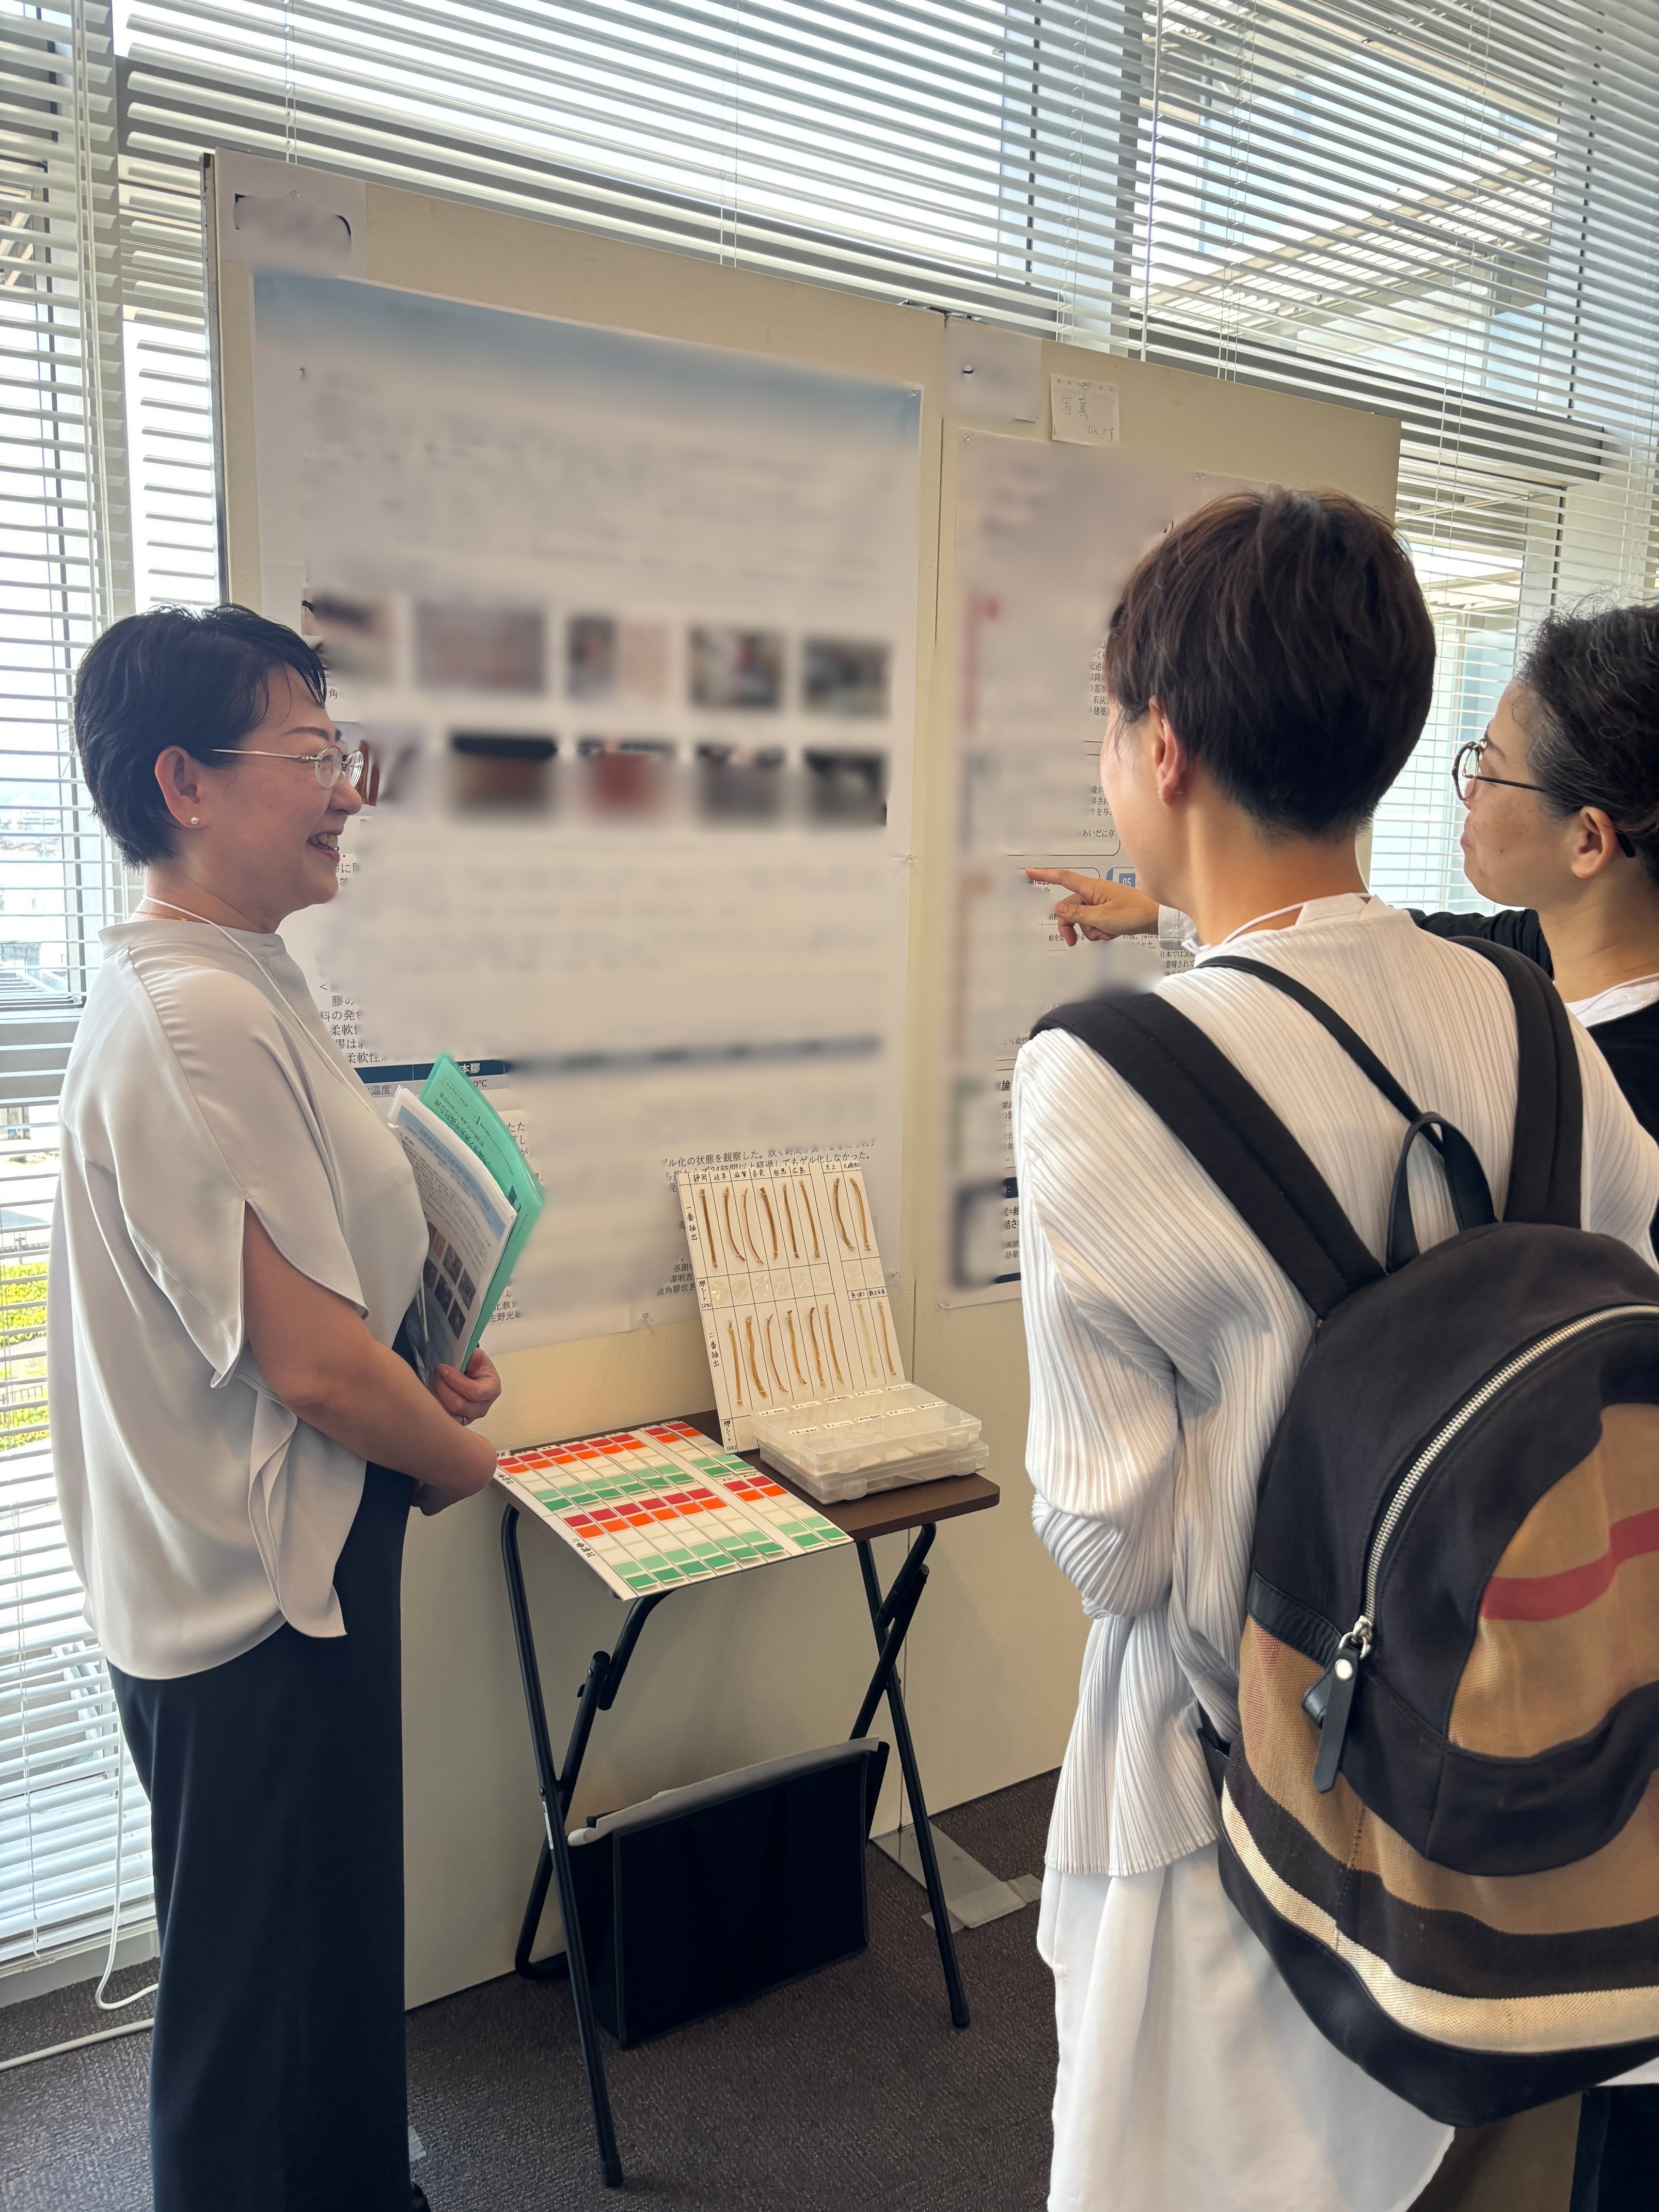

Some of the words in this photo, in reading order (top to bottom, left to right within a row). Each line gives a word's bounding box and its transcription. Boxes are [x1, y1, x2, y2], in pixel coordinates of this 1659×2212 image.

[1062, 397, 1088, 417] 写真
[345, 1052, 387, 1064] 柔軟性
[368, 1085, 391, 1096] 温度
[686, 1206, 698, 1241] 一番抽出
[708, 1332, 720, 1367] 二番抽出
